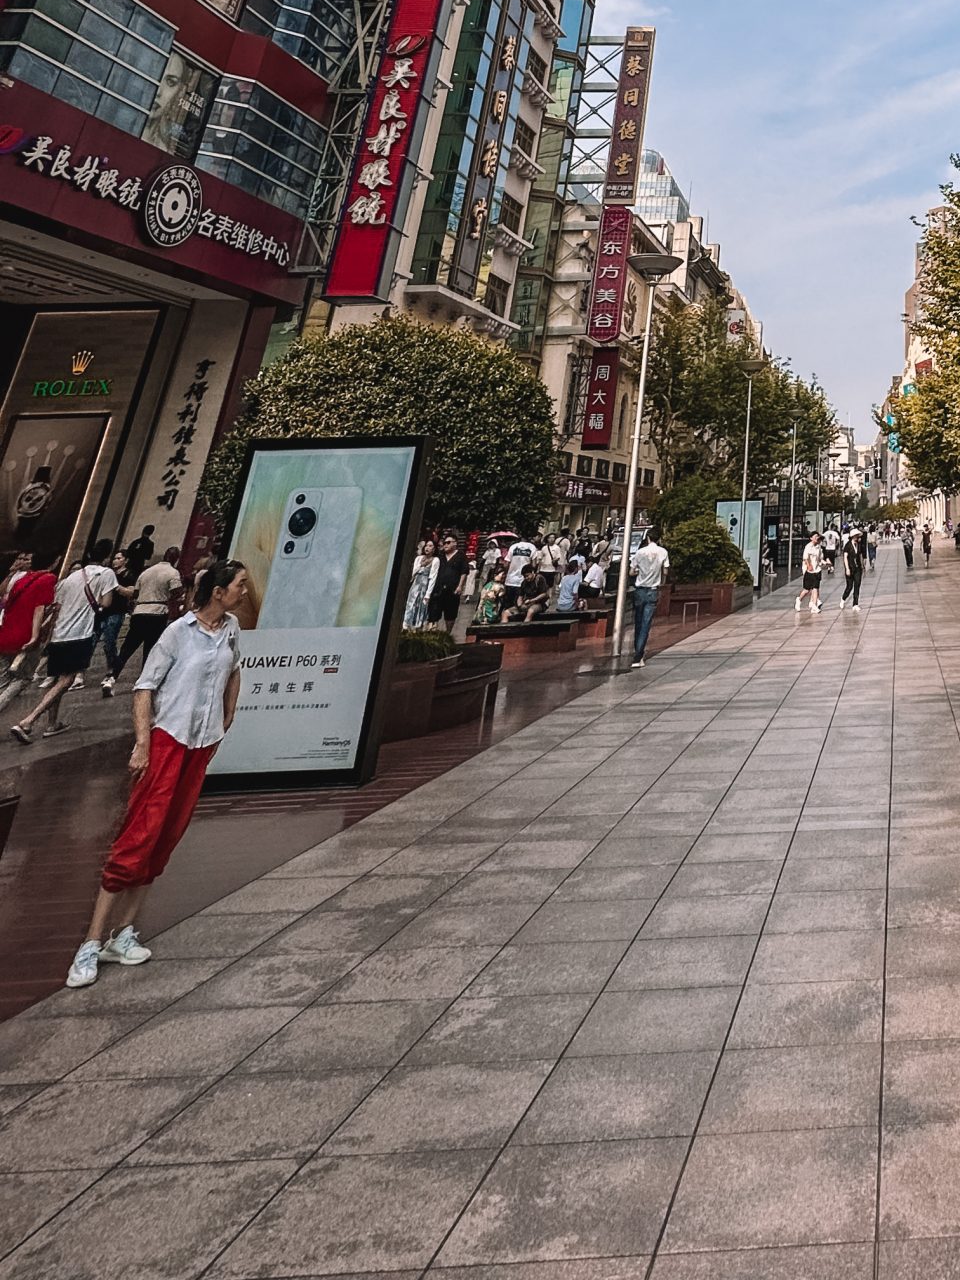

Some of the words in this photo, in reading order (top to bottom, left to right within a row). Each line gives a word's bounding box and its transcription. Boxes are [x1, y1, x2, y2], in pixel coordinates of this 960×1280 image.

[614, 54, 645, 176] 蔡同德堂
[22, 136, 143, 211] 吴良材眼镜
[198, 208, 290, 267] 名表维修中心
[593, 240, 623, 328] 东方美谷
[33, 379, 113, 397] ROLEX
[588, 364, 611, 431] 周大福
[251, 681, 315, 695] 万境生辉
[295, 654, 318, 667] P60
[319, 654, 342, 667] 系列
